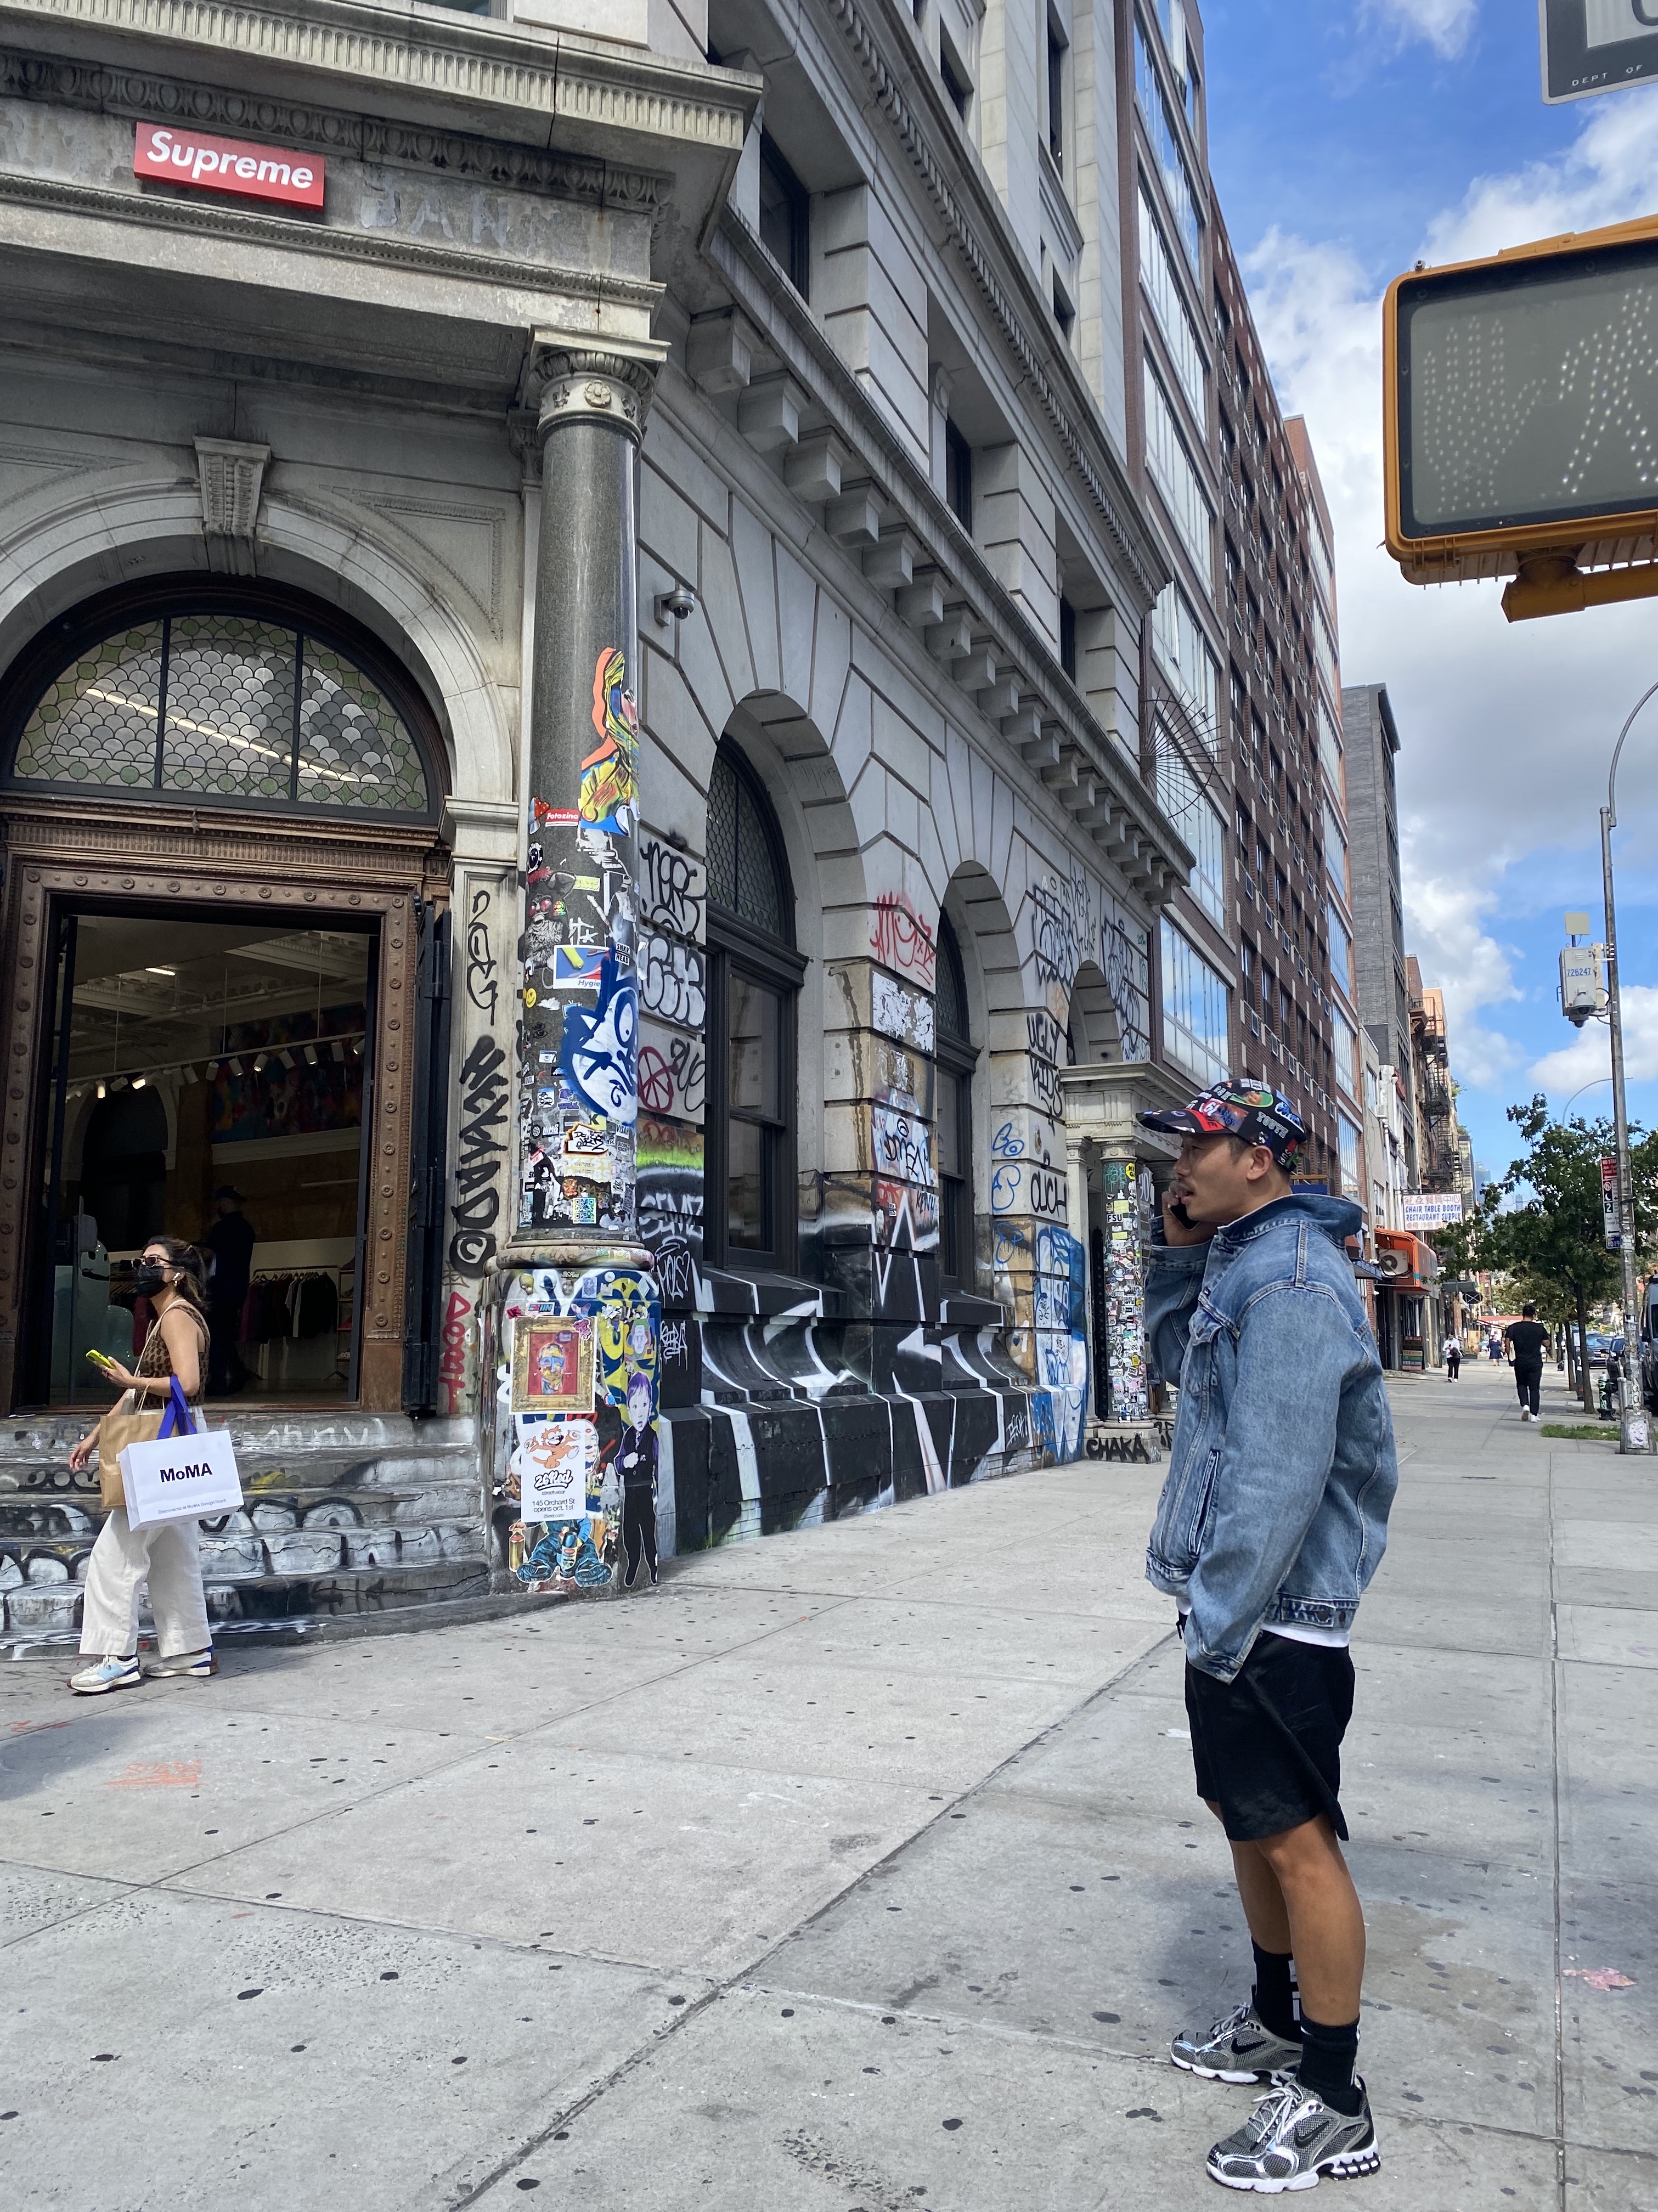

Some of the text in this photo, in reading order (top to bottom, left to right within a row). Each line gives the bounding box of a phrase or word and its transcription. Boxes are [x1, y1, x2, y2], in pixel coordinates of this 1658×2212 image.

[1626, 64, 1643, 74] OF
[146, 131, 313, 189] Supreme
[616, 953, 629, 964] HEAD
[1566, 967, 1591, 976] 726247
[1027, 1012, 1061, 1060] UGLY
[1256, 1111, 1290, 1139] YOUTH
[1405, 1205, 1423, 1214] CHAIR
[1443, 1204, 1461, 1212] BOOTH
[1606, 1203, 1612, 1213] 2
[1107, 1214, 1123, 1223] FSU
[1406, 1212, 1461, 1221] RESTAURANT SUPPLY
[1086, 1434, 1151, 1464] CHAKA
[160, 1463, 213, 1483] MoMA
[534, 1469, 574, 1490] 26Red
[158, 1506, 182, 1514] Discovered
